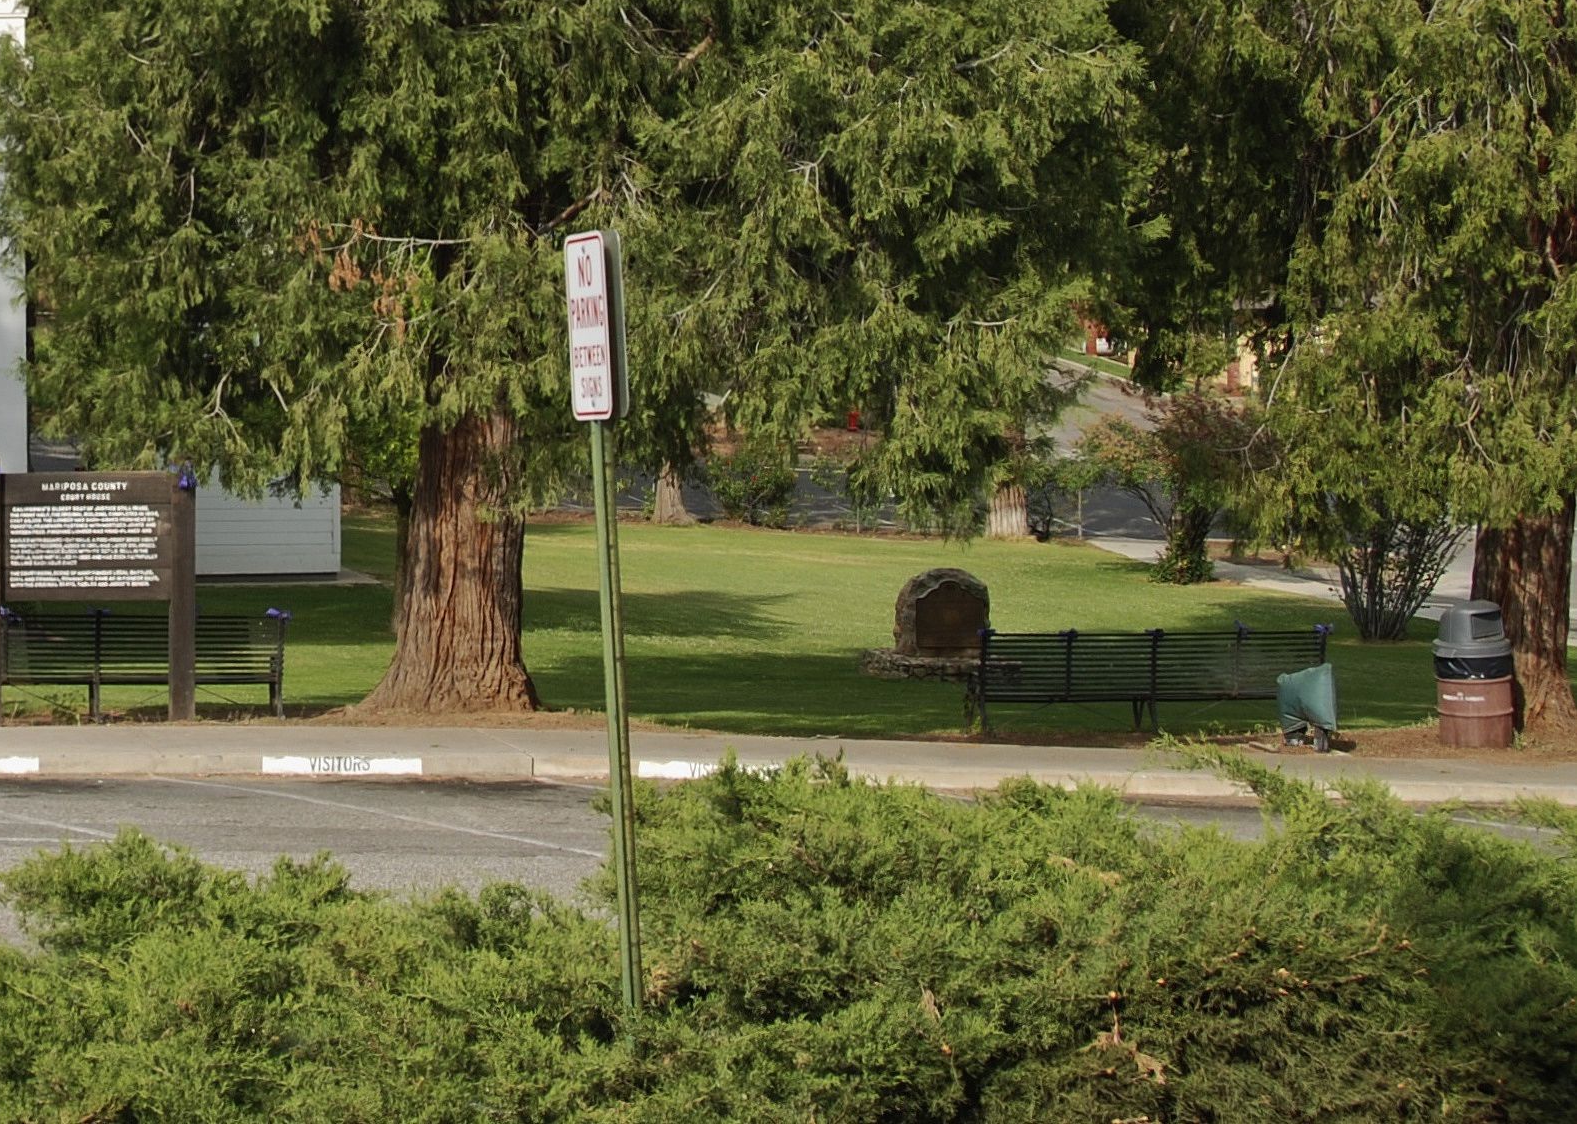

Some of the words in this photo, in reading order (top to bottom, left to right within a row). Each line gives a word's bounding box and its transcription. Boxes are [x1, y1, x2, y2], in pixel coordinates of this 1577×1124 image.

[577, 255, 593, 287] NO
[571, 295, 604, 329] PARKING
[574, 344, 606, 369] BETWEEN
[581, 376, 603, 399] SIGNS
[41, 482, 89, 492] MARIPOSA
[91, 481, 128, 491] COUNTY
[309, 756, 370, 772] VISITORS
